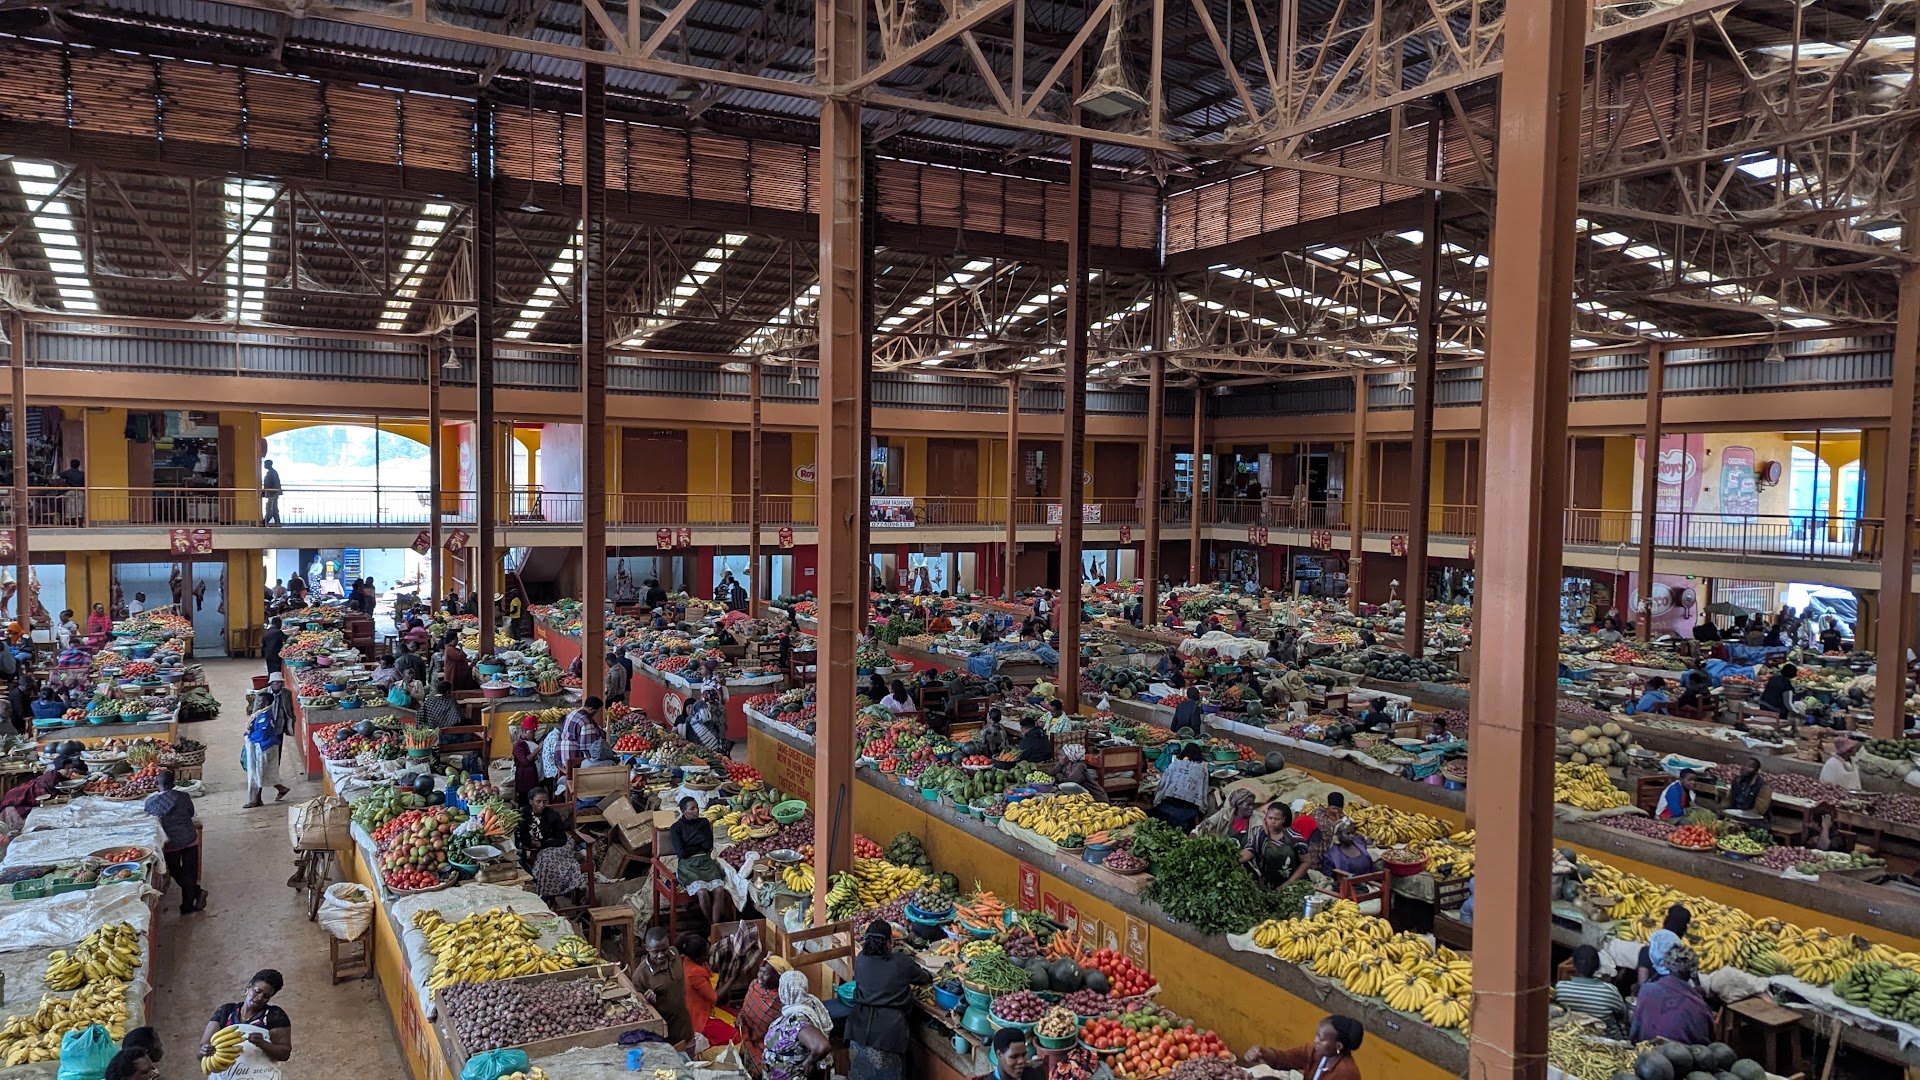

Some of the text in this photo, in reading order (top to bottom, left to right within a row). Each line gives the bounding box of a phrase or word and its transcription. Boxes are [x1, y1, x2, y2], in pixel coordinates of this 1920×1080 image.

[800, 469, 815, 480] Roy
[789, 747, 801, 762] GREAT
[777, 752, 787, 765] NOW
[792, 760, 802, 774] NEW
[787, 767, 796, 780] FOR
